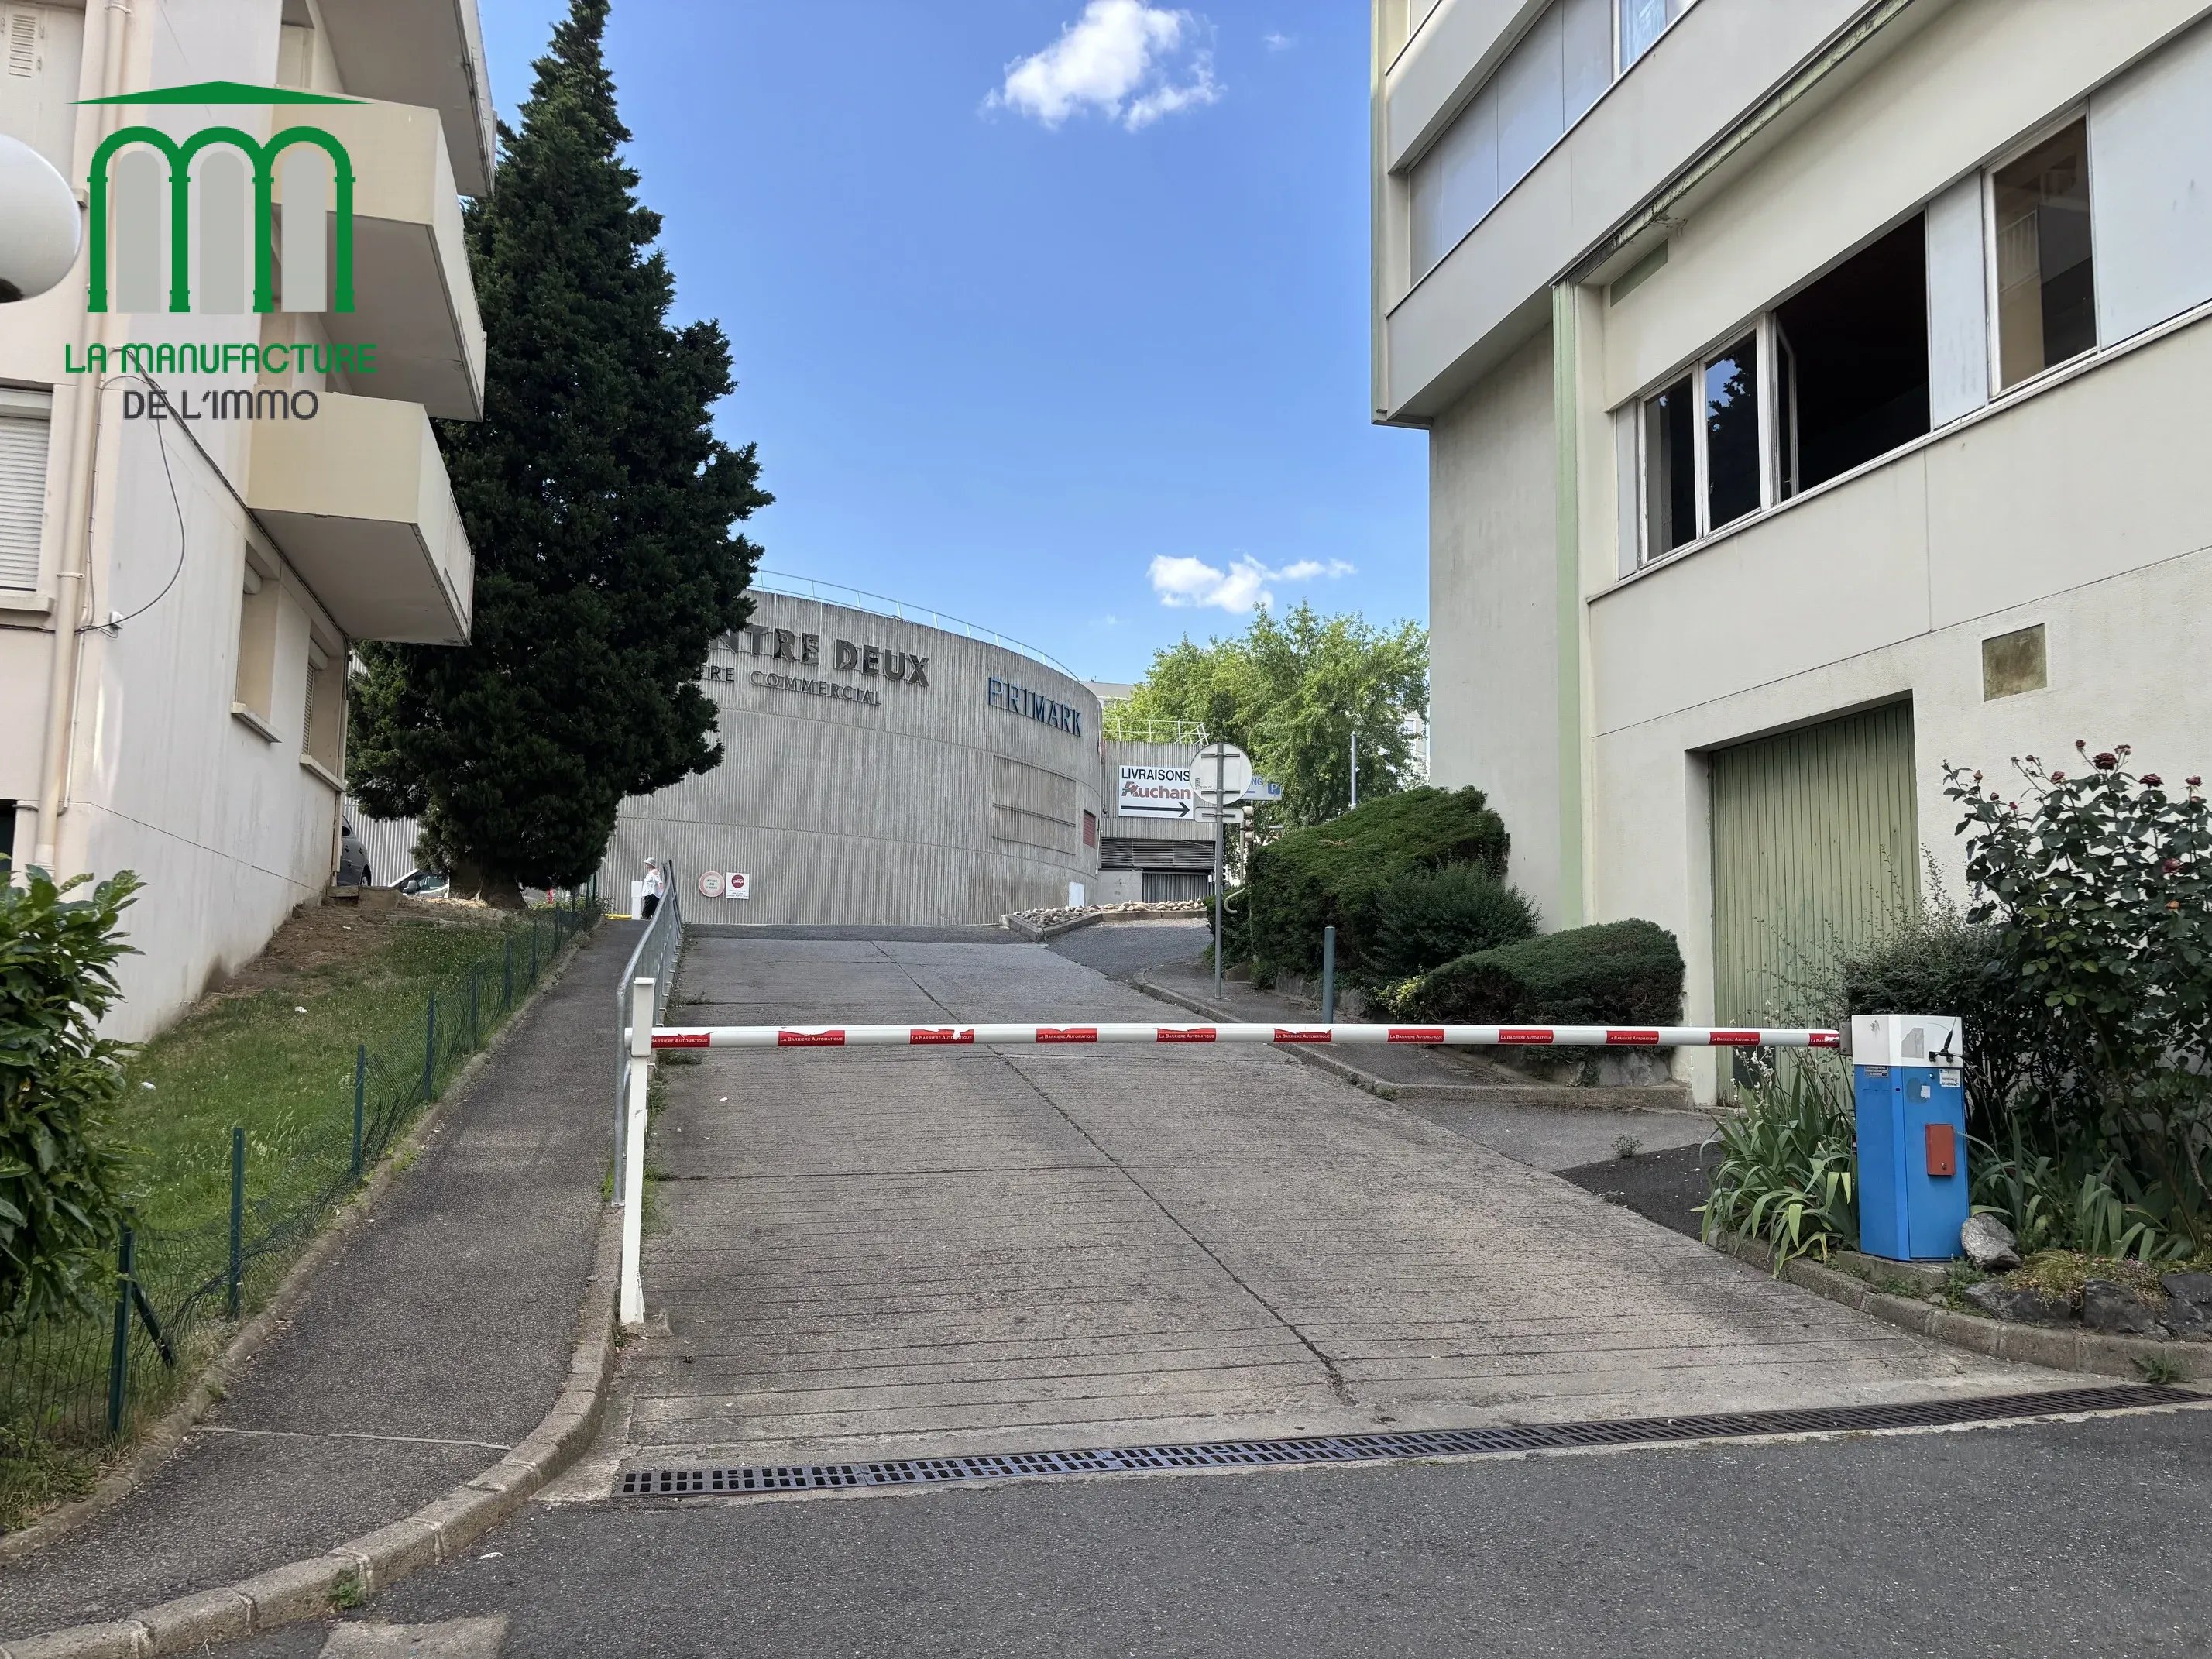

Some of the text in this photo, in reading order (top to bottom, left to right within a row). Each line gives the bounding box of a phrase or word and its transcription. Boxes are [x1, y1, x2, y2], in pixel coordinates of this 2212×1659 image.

[834, 639, 929, 686] DEUX
[749, 670, 882, 706] COMMERCIAL
[988, 675, 1081, 737] PRIMARK
[1121, 768, 1190, 782] LIVRAISONS
[1121, 781, 1191, 799] Auchan
